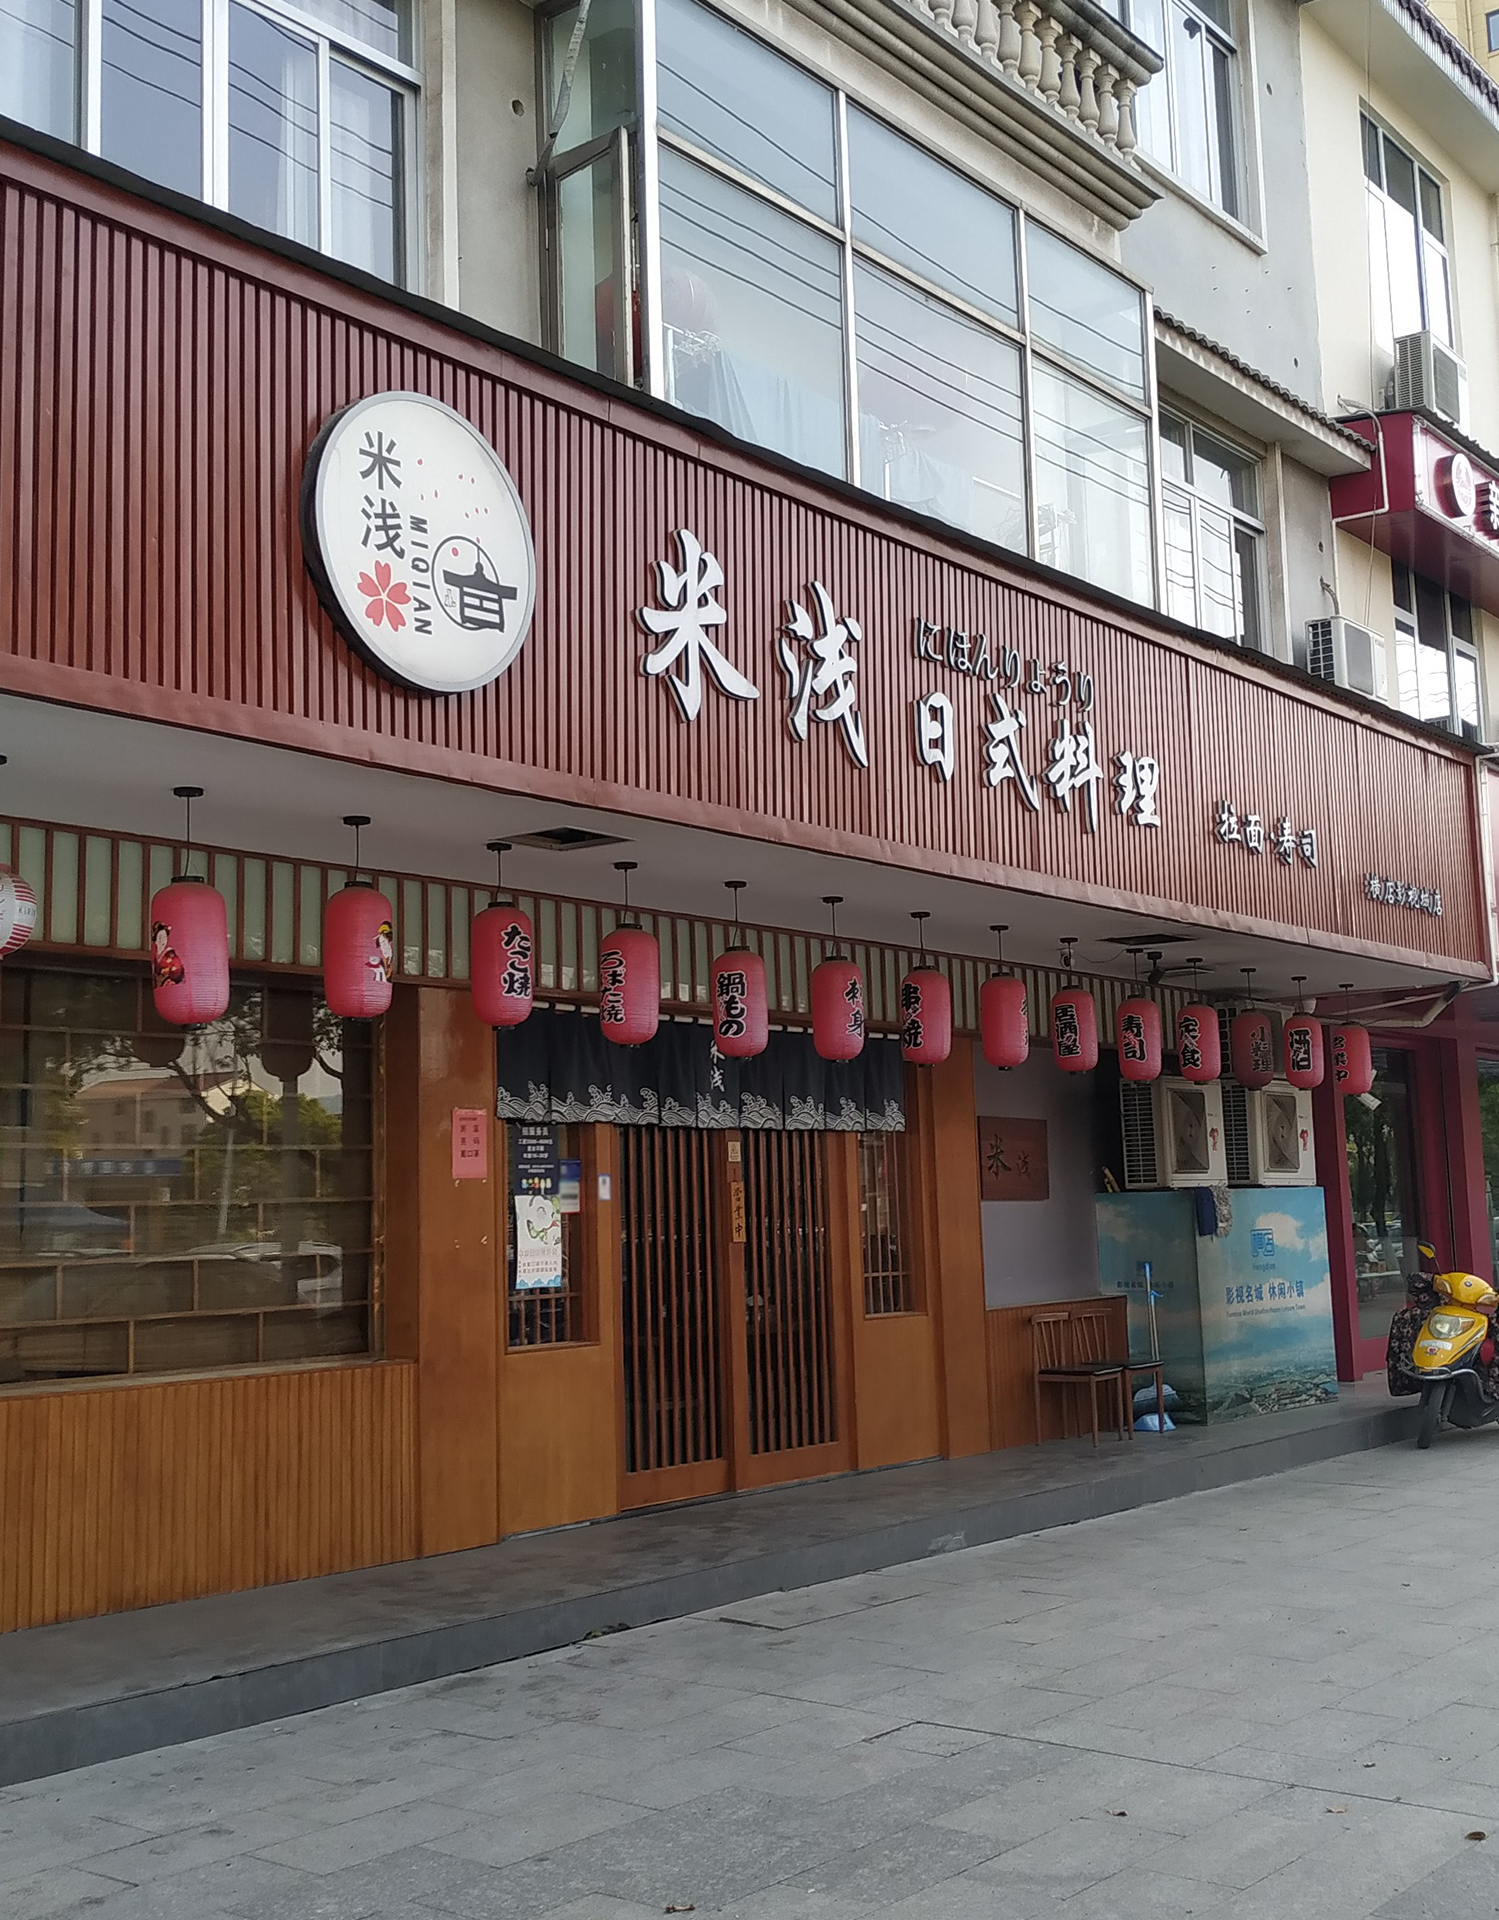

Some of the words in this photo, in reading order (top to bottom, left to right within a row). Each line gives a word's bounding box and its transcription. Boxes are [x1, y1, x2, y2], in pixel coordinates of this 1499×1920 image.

[358, 430, 406, 560] 米浅
[409, 514, 434, 636] MIQIAN
[635, 528, 869, 769] 米浅
[913, 691, 1162, 834] 日式料理
[914, 616, 1095, 713] にほんりょうり
[501, 923, 532, 999] たこ焼
[716, 971, 747, 1037] 鍋もの
[843, 975, 865, 1040] 刺身
[1054, 1003, 1082, 1058] 居酒屋
[1120, 1014, 1148, 1063] 寿司
[1179, 1015, 1202, 1070] 定食
[1249, 1025, 1272, 1073] 小料理
[1225, 1283, 1264, 1305] 影视名城
[1268, 1280, 1305, 1300] 休闲小镇
